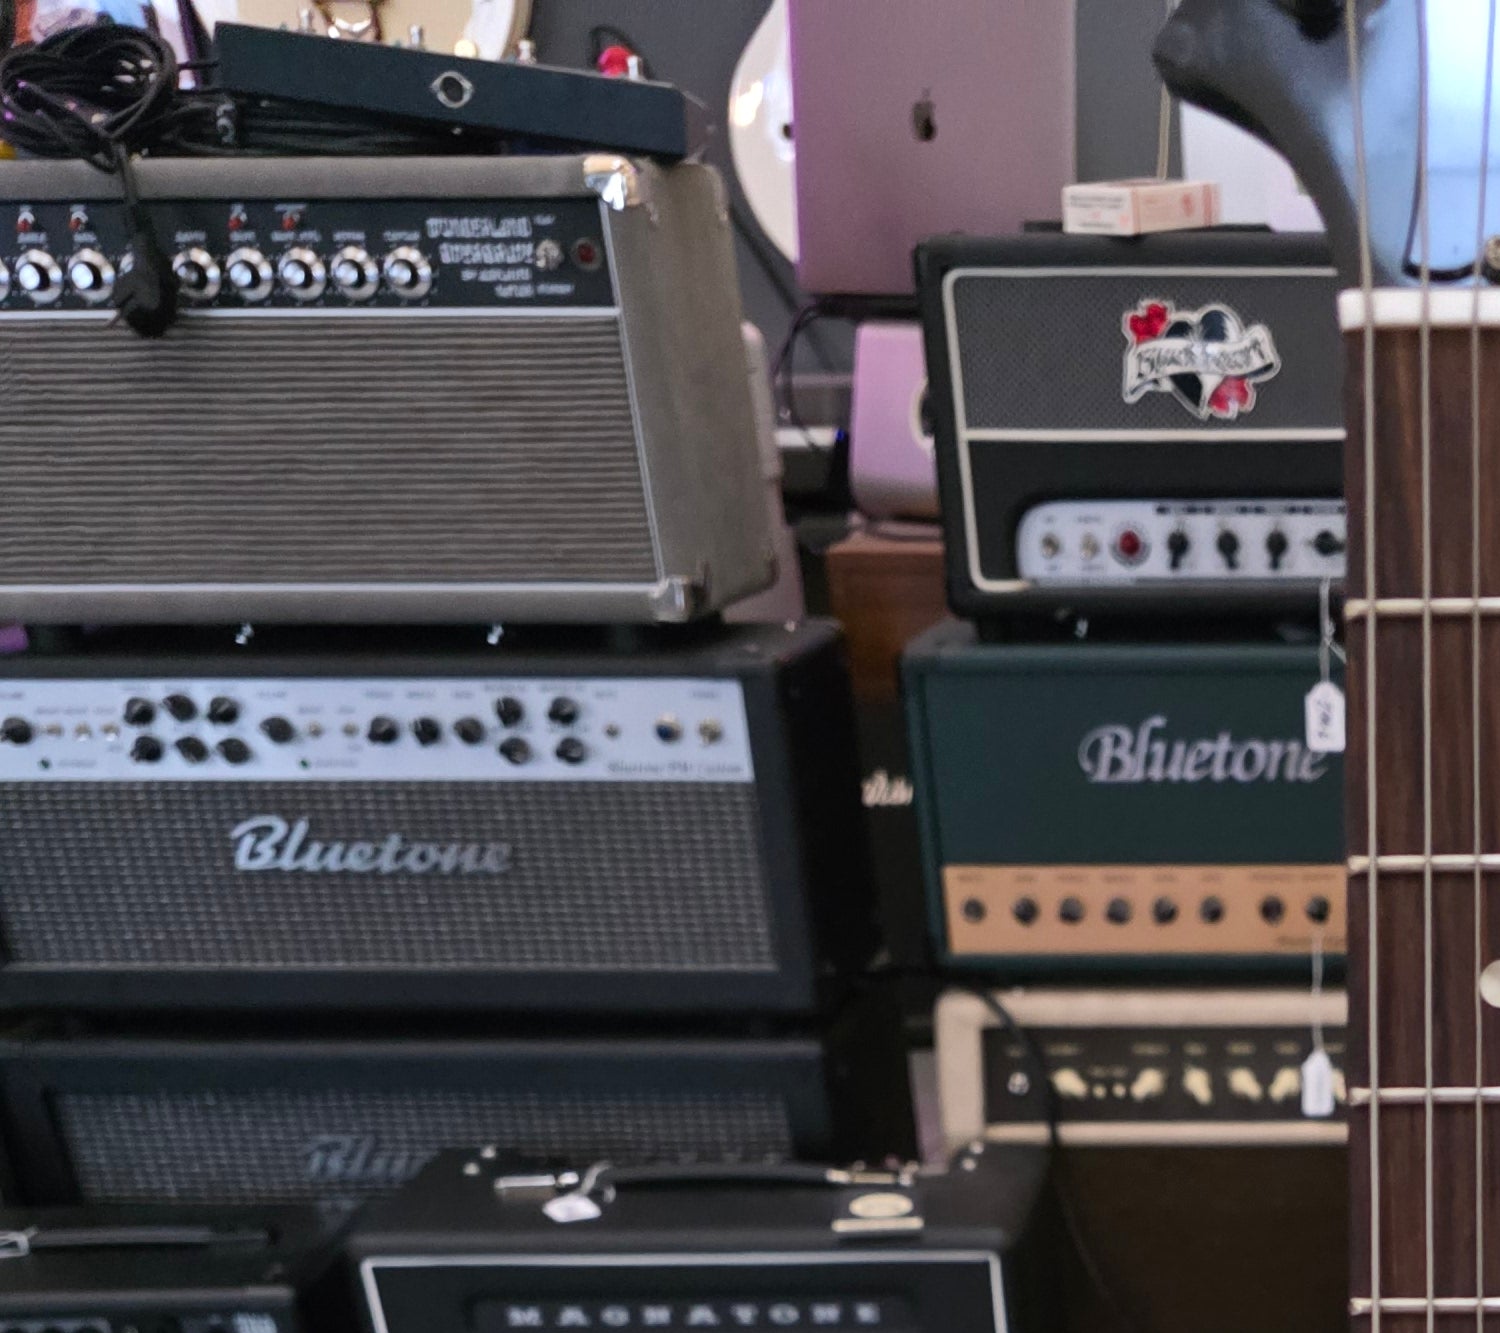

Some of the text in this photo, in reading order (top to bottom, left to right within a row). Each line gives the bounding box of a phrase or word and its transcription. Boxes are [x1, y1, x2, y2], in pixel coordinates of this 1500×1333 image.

[1079, 717, 1330, 783] Bluetone
[230, 814, 515, 874] Bluetone
[505, 1303, 883, 1328] MAGNATONE
